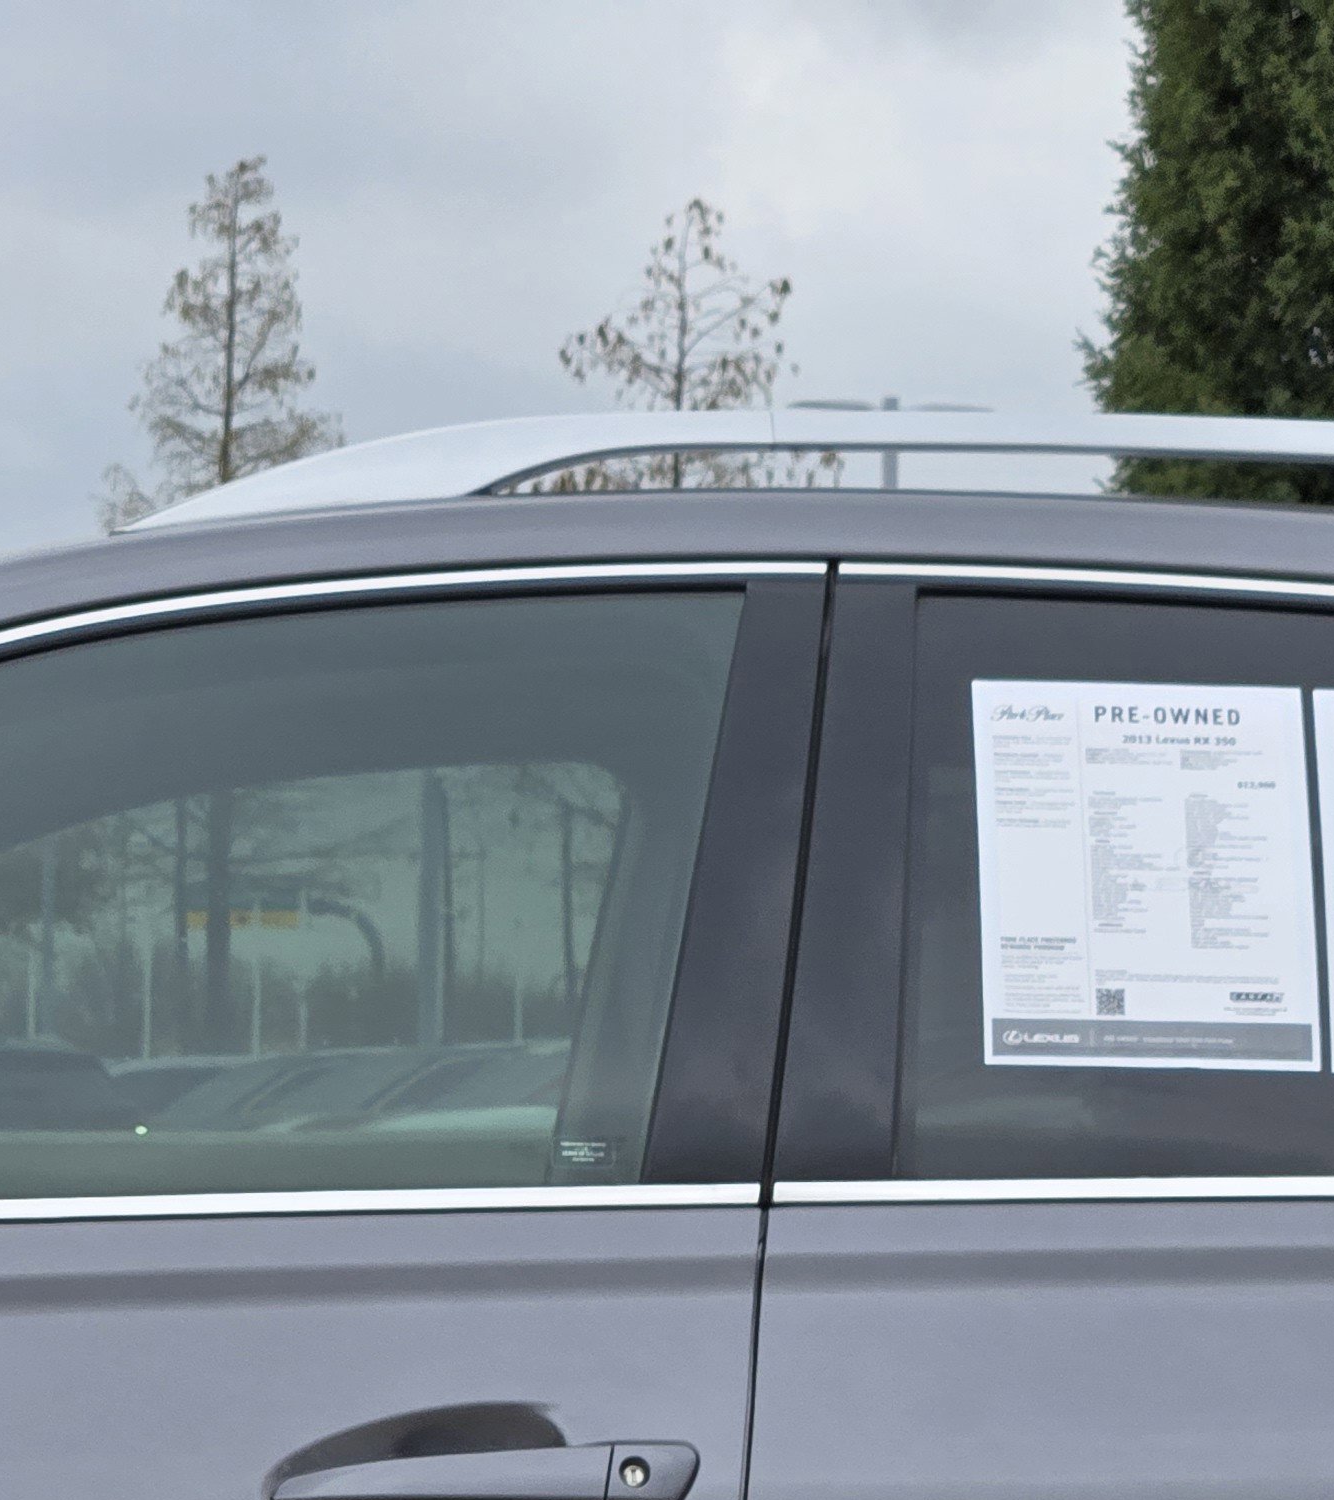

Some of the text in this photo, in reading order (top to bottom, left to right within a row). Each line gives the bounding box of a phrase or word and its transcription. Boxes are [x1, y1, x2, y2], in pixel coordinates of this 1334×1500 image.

[1094, 705, 1241, 726] PRE-OWNED
[1122, 734, 1237, 747] 2013 Lexus RX 350
[1023, 1031, 1080, 1044] LEXUS
